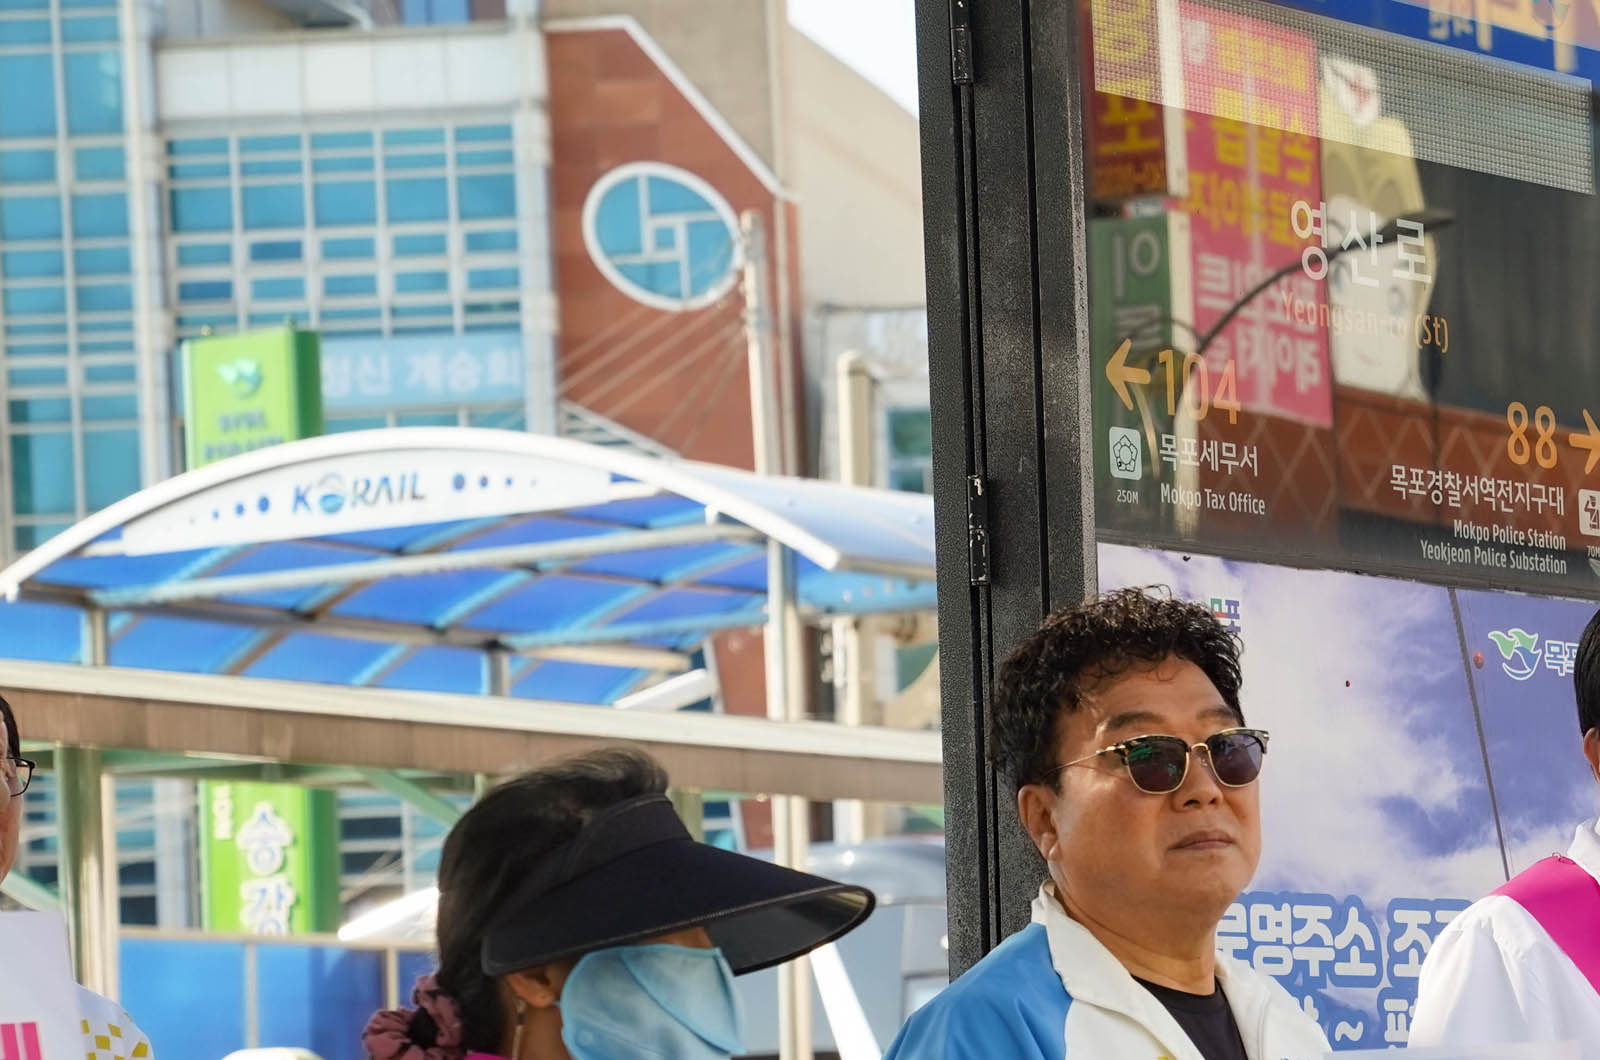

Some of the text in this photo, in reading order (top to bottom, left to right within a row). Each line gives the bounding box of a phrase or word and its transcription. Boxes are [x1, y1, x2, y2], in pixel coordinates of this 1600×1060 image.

[1291, 200, 1432, 289] 영산로
[1414, 313, 1449, 354] (St)
[1159, 349, 1241, 425] 104
[1160, 433, 1258, 477] 목포세무서
[1507, 401, 1558, 469] 88
[293, 472, 426, 515] KORAIL
[1116, 489, 1139, 504] 250M
[1160, 483, 1266, 516] Mokpo Tax Office
[1390, 464, 1565, 516] 목포경찰서역전지구대
[1453, 519, 1567, 551] Mokpo Police Station
[1587, 545, 1600, 558] 70M
[1420, 540, 1567, 575] Yeokjeon Police Substation
